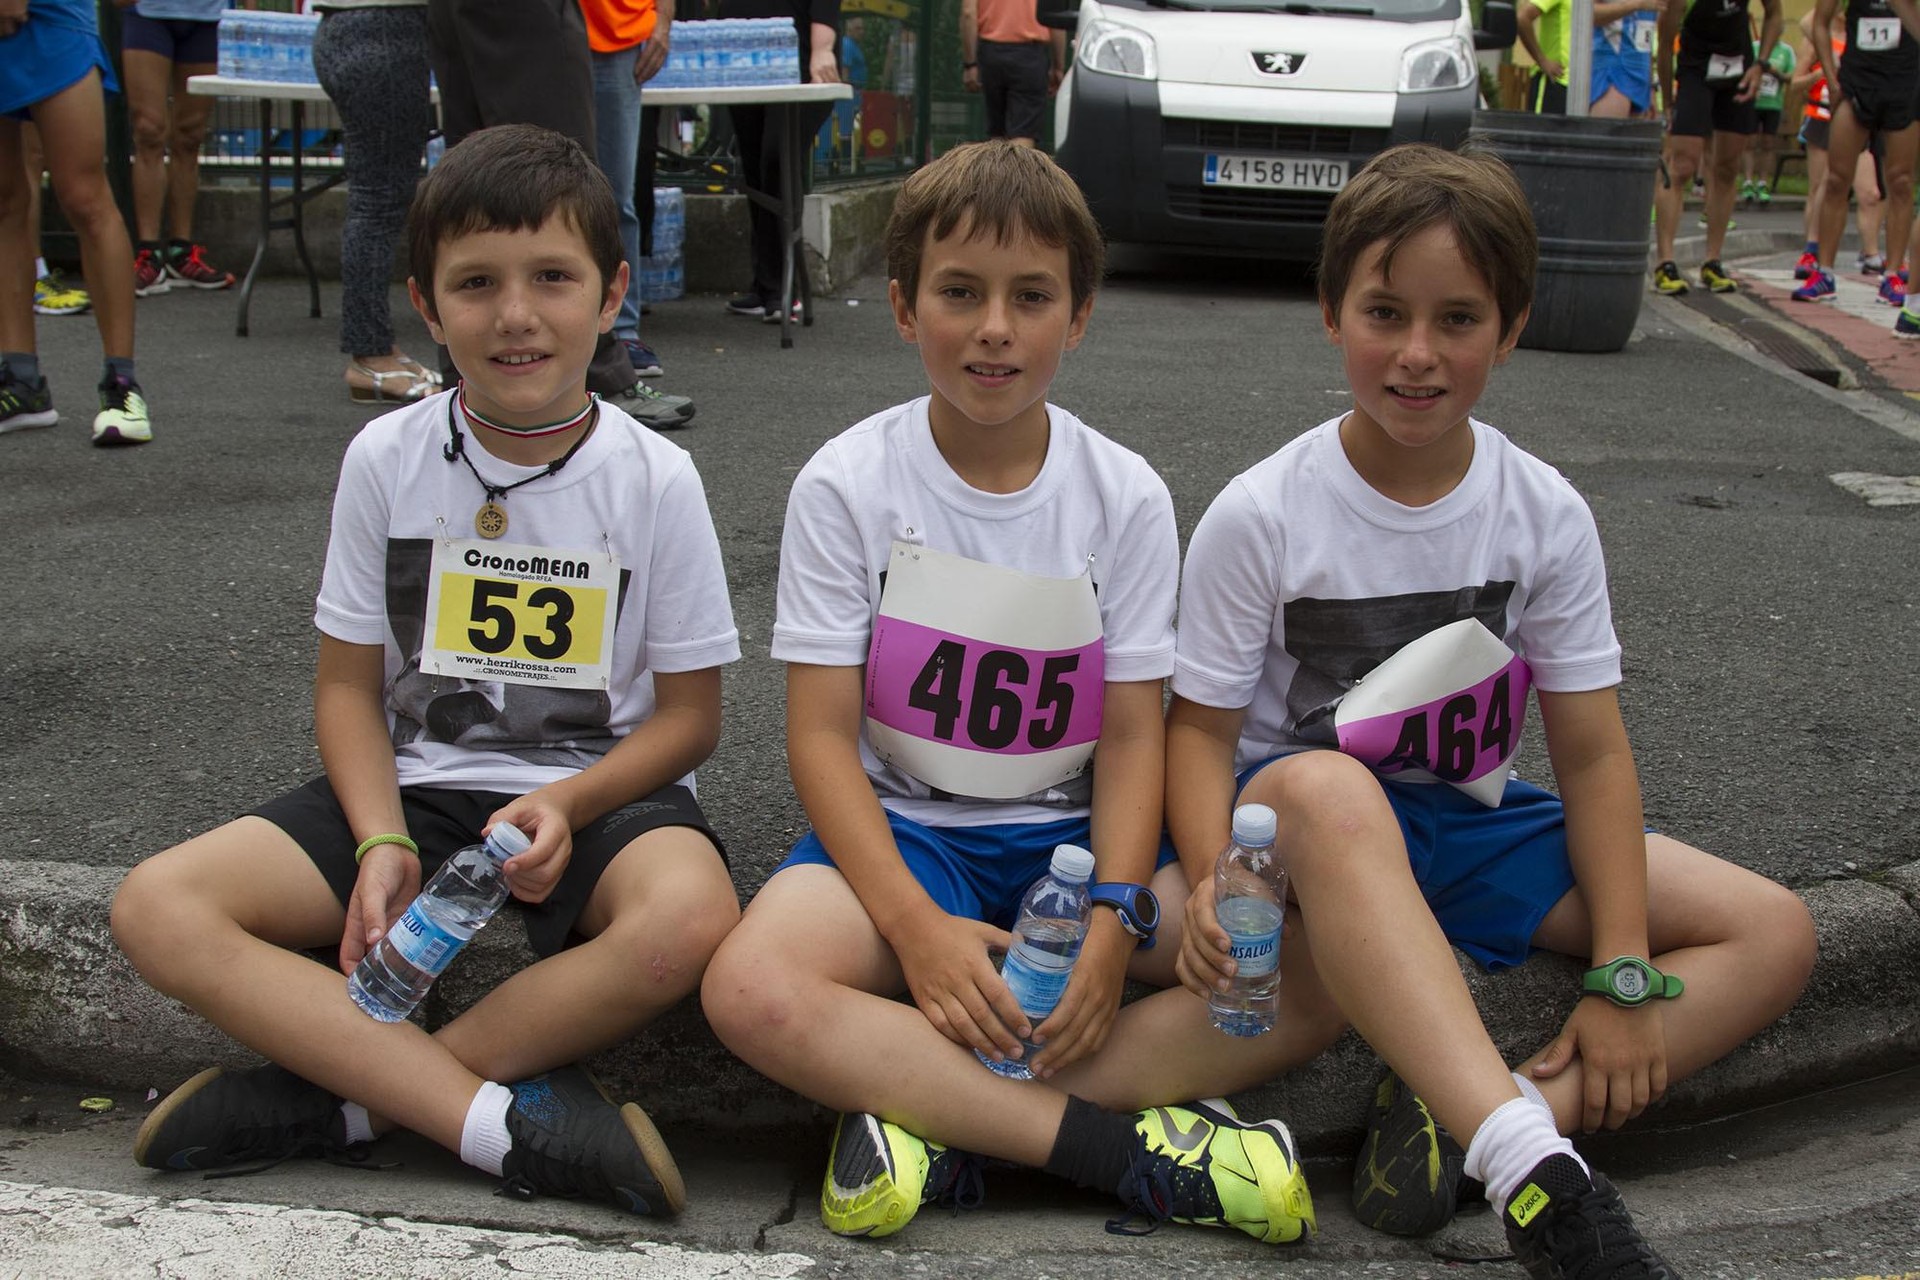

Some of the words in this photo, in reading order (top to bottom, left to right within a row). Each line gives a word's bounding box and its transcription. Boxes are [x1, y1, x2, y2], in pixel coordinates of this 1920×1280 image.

[1868, 28, 1889, 41] 11
[1721, 63, 1731, 75] 7
[1219, 158, 1285, 185] 4158
[1293, 162, 1342, 188] HVD
[536, 574, 553, 583] RFEA
[467, 578, 575, 660] 53
[455, 654, 577, 675] www.herrikrossa.com
[907, 638, 1081, 750] 465
[1377, 670, 1512, 782] 464
[602, 803, 679, 835] adidas
[400, 911, 426, 937] SALUS
[1229, 940, 1274, 960] NSALUS
[1523, 1191, 1542, 1212] asics
